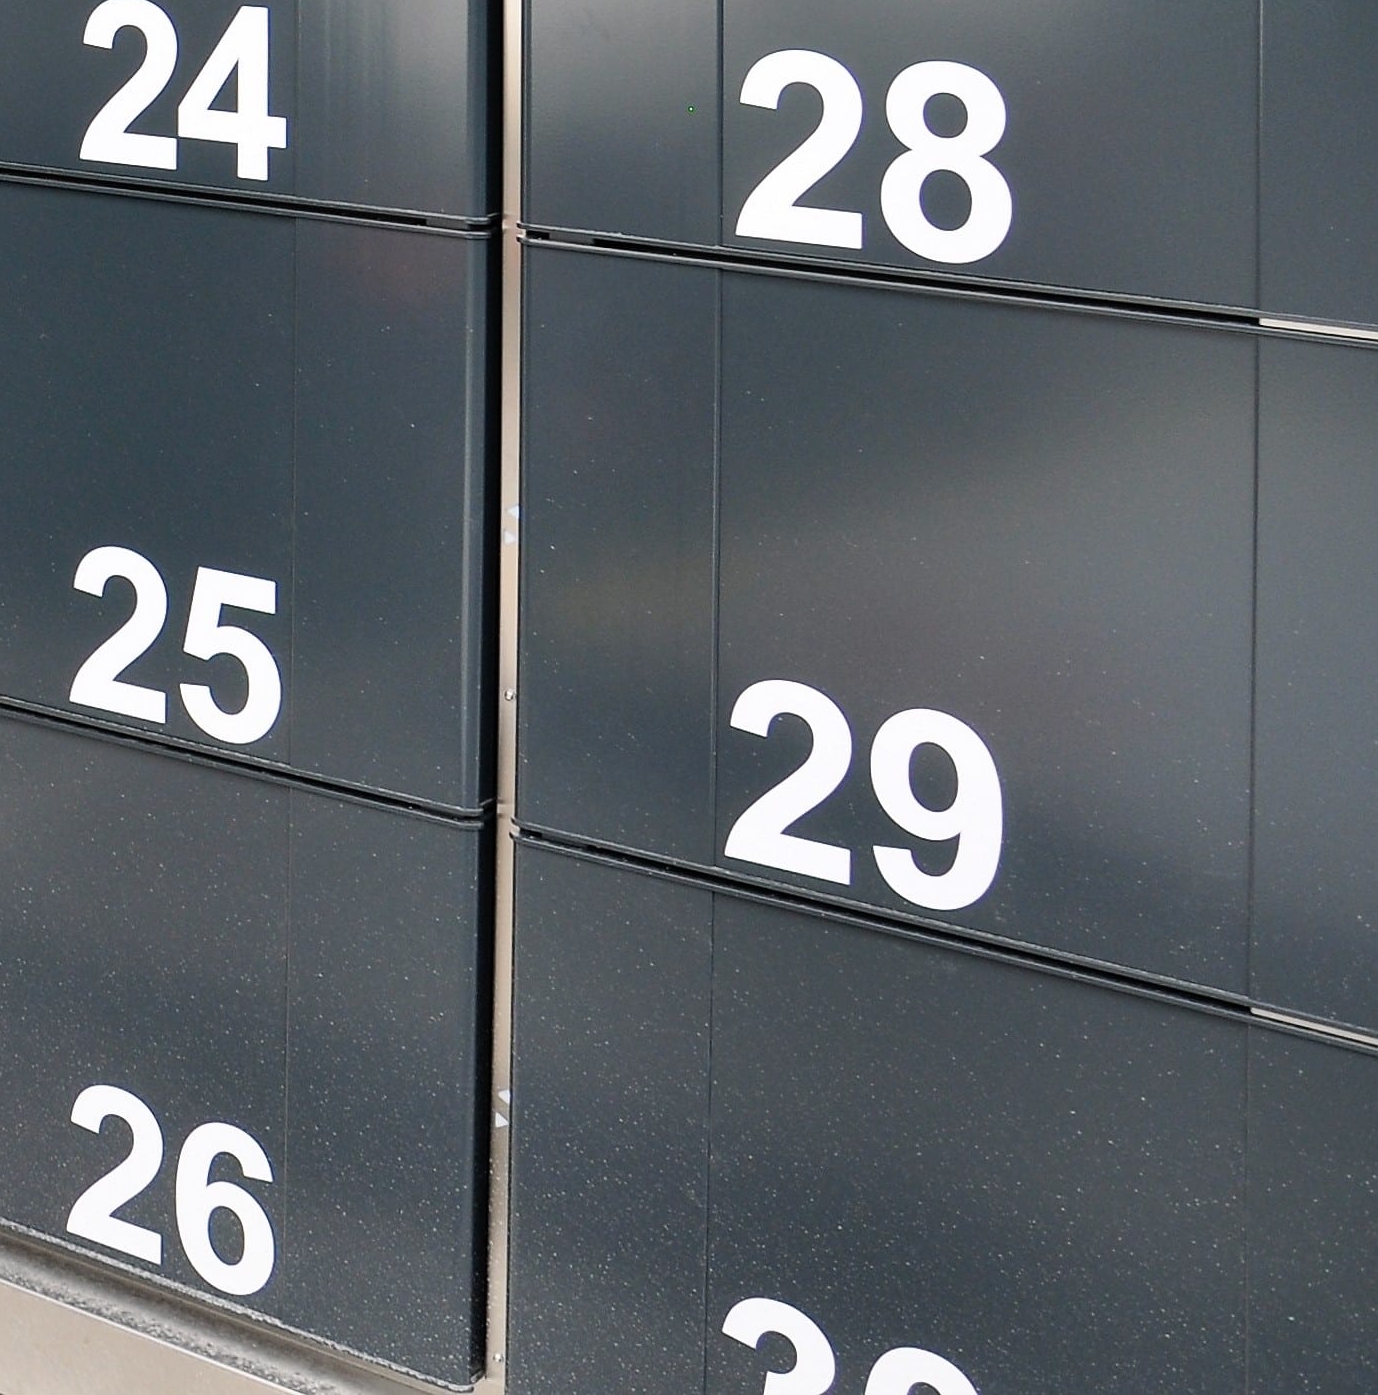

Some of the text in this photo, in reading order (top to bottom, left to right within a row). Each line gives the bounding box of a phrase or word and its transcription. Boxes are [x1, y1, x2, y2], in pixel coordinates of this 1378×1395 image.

[735, 49, 1013, 264] 28
[69, 546, 281, 744] 25
[724, 679, 1003, 911] 29
[66, 1084, 275, 1296] 26
